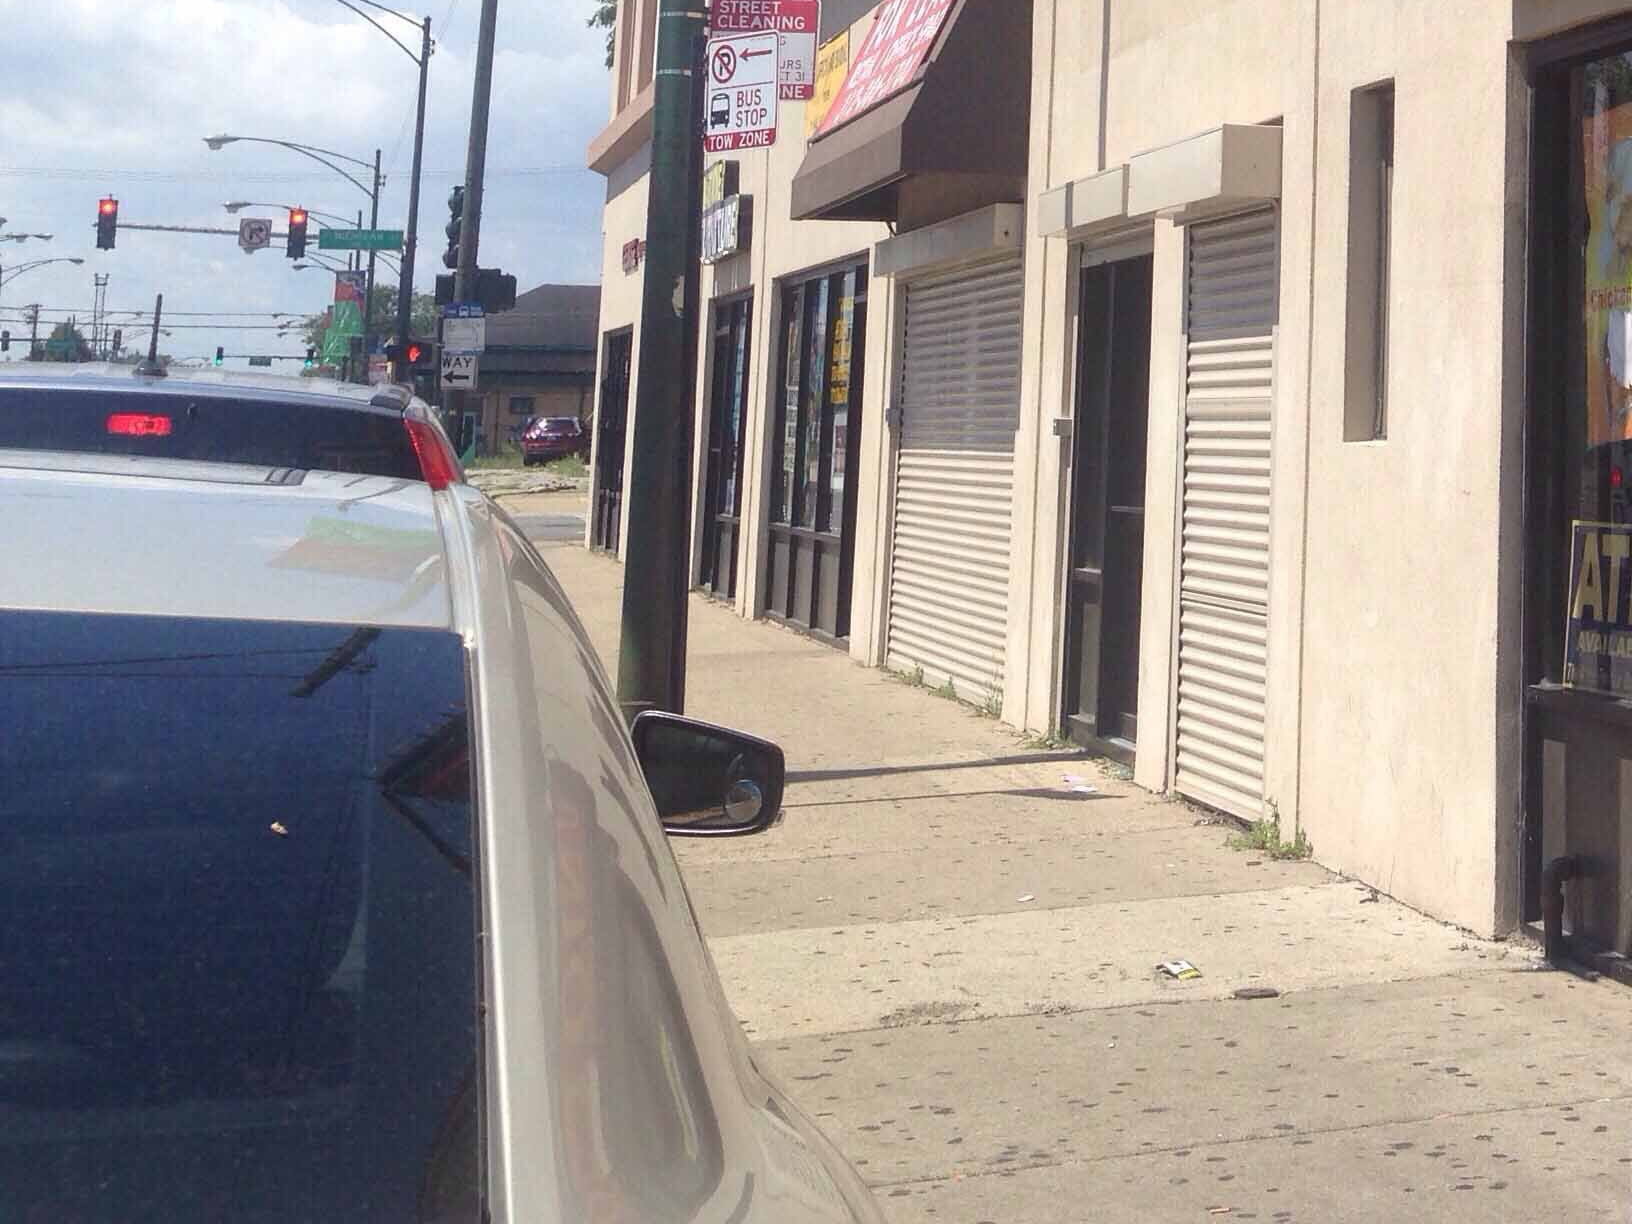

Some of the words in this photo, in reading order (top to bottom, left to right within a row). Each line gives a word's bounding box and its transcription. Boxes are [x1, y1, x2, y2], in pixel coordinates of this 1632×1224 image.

[719, 0, 782, 14] STREET
[717, 15, 806, 30] CLEANING
[737, 89, 762, 108] BUS
[735, 108, 768, 127] STOP
[710, 135, 734, 150] TOW
[739, 131, 771, 147] ZONE
[443, 357, 472, 369] WAY
